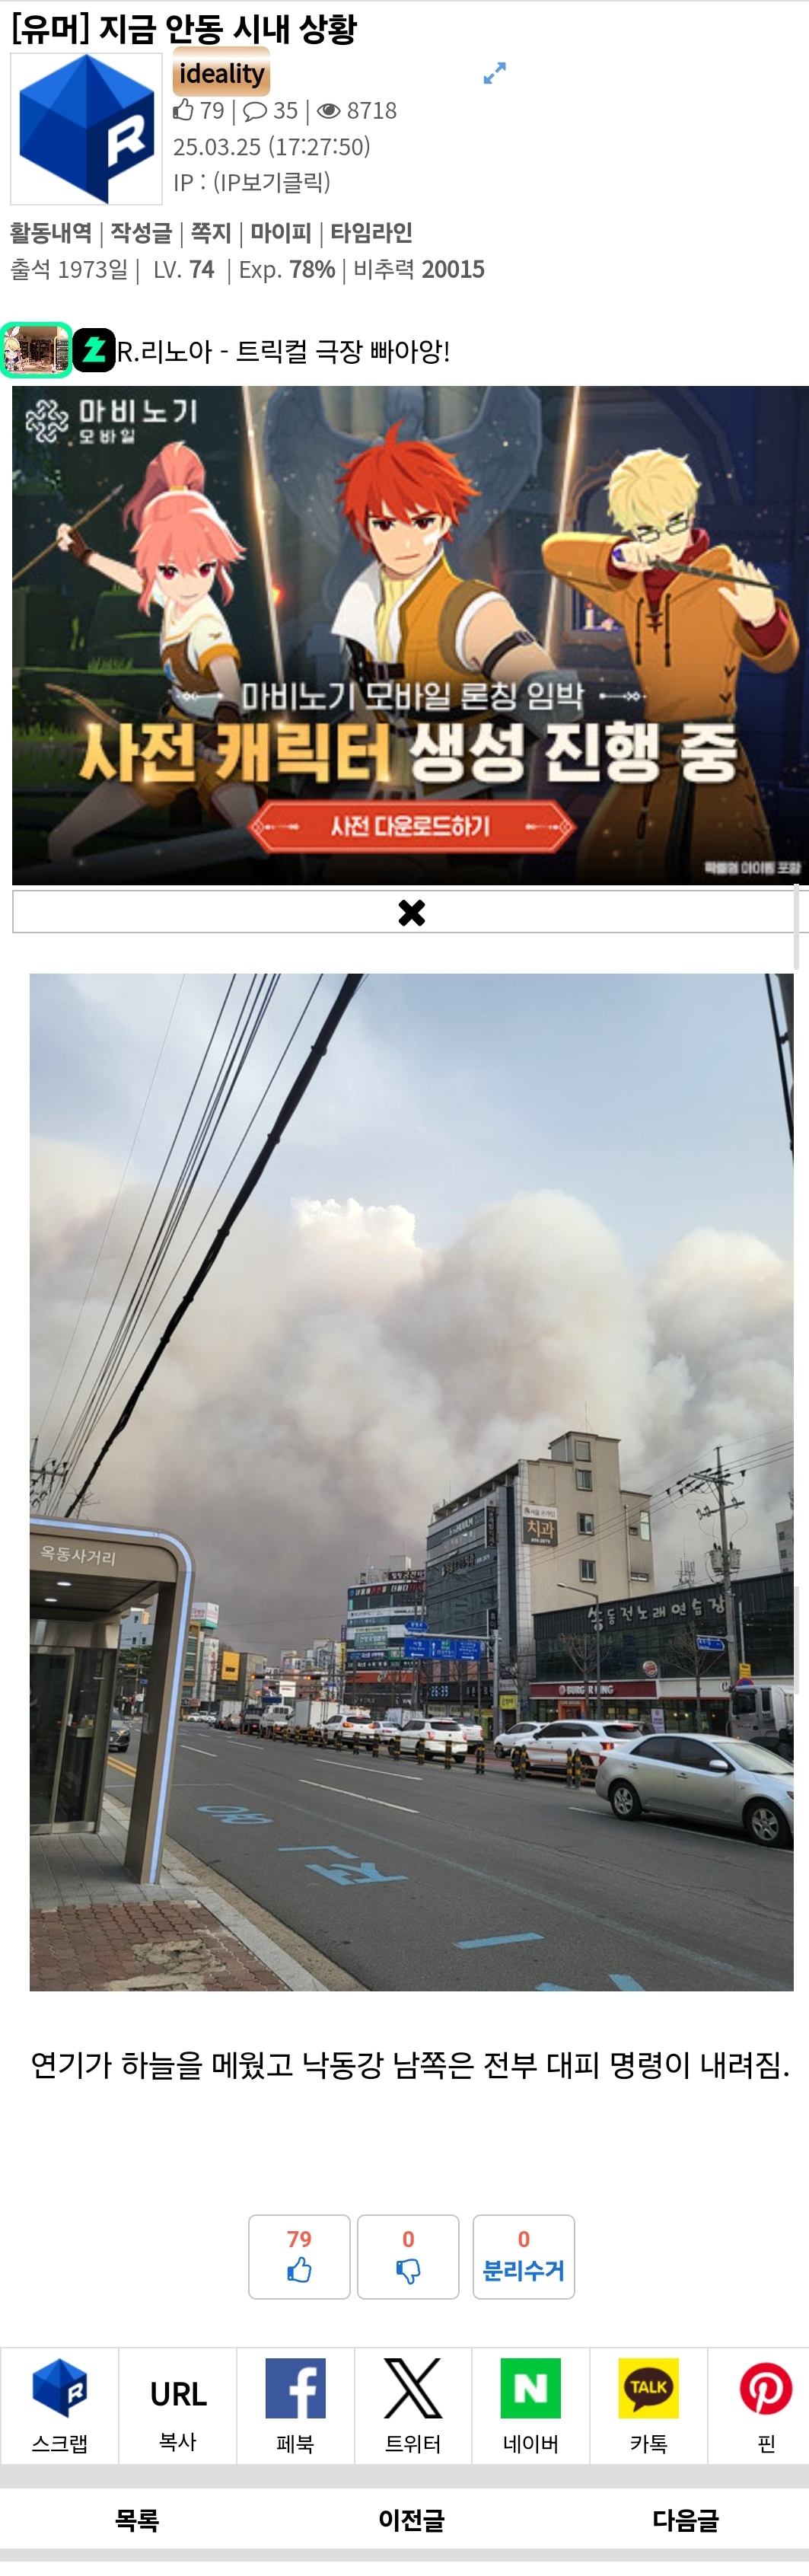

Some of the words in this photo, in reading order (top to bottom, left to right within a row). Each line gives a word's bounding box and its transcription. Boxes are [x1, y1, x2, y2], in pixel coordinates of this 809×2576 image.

[13, 12, 88, 44] [유머]
[100, 14, 156, 44] 지금
[167, 14, 223, 45] 안동
[233, 14, 288, 44] 시내
[299, 14, 357, 45] 상황
[180, 62, 265, 88] ideality
[202, 102, 224, 119] 79
[274, 102, 298, 119] 35
[348, 102, 397, 119] 8718
[174, 139, 260, 155] 25.03.25
[269, 135, 369, 158] (17:27:50)
[175, 174, 193, 191] IP
[215, 171, 330, 194] (IP보기클릭)
[10, 222, 91, 244] 활동내역
[111, 222, 172, 244] 작성글
[192, 222, 230, 244] 쪽지
[252, 222, 311, 244] 마이피
[332, 222, 412, 244] 타임라인
[11, 259, 49, 280] 출석
[59, 260, 126, 279] 1973일
[155, 261, 181, 278] LV.
[190, 260, 215, 278] 74
[240, 261, 281, 283] Exp.
[290, 260, 336, 278] 78%
[355, 260, 412, 280] 비추력
[422, 260, 484, 278] 20015
[119, 340, 212, 364] R.리노아
[237, 340, 306, 364] 트릭컬
[316, 340, 363, 365] 극장
[371, 340, 449, 364] 빠아앙!
[80, 399, 196, 424] 마비노기
[80, 429, 135, 444] 모바일
[243, 682, 355, 711] 마비노기
[365, 682, 450, 711] 모바일
[461, 682, 516, 711] 론칭
[527, 682, 584, 711] 임박
[79, 722, 195, 783] 사전
[215, 722, 390, 783] 캐릭터
[409, 722, 524, 783] 생성
[545, 721, 660, 783] 진행
[680, 722, 737, 783] 중
[331, 815, 369, 837] 사전
[374, 815, 490, 837] 다운로드하기
[527, 1519, 554, 1538] 치과
[41, 1545, 115, 1567] 옥동사거리
[566, 1685, 594, 1694] BURGR
[32, 2052, 112, 2079] 연기가
[122, 2052, 202, 2080] 하늘을
[213, 2052, 293, 2080] 메웠고
[304, 2052, 384, 2080] 낙동강
[394, 2052, 474, 2080] 남쪽은
[484, 2052, 537, 2079] 전부
[548, 2052, 597, 2079] 대피
[611, 2052, 688, 2079] 명령이
[702, 2052, 788, 2079] 내려짐.
[288, 2231, 311, 2247] 79
[403, 2231, 414, 2247] 0
[519, 2231, 529, 2247] 0
[483, 2260, 563, 2281] 분리수거
[151, 2382, 207, 2406] URL
[630, 2381, 667, 2393] TALK
[32, 2435, 86, 2453] 스크랩
[160, 2432, 196, 2452] 복사
[277, 2435, 314, 2454] 페북
[386, 2435, 439, 2453] 트위터
[505, 2435, 557, 2453] 네이버
[631, 2434, 667, 2454] 카톡
[759, 2435, 775, 2453] 핀
[116, 2509, 159, 2533] 목록
[380, 2509, 444, 2533] 이전글
[654, 2509, 719, 2533] 다음글
